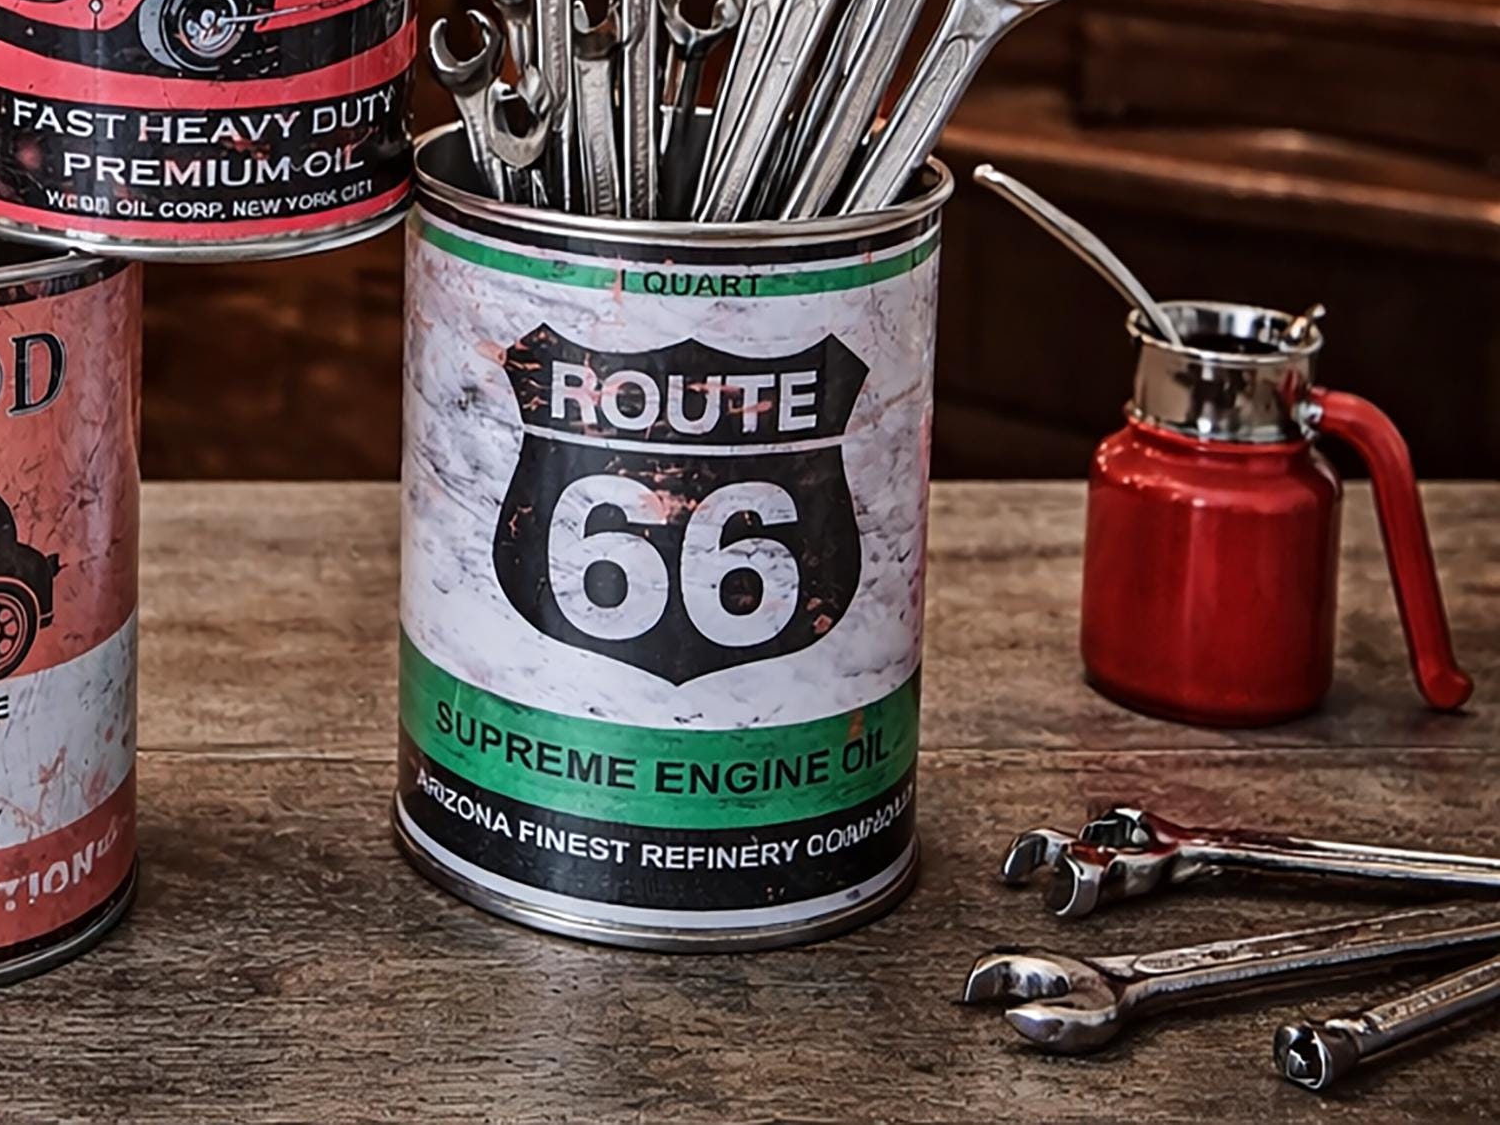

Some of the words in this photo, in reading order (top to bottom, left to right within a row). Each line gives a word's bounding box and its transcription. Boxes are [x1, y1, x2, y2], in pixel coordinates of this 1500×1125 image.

[12, 97, 125, 141] FAST
[137, 111, 301, 145] HEAVY
[312, 85, 395, 135] DUTY
[63, 152, 291, 187] PREMIUM
[304, 144, 364, 178] OIL
[116, 200, 153, 217] OIL
[158, 201, 227, 219] CORP.
[232, 197, 282, 217] NEW
[643, 271, 762, 297] QUART
[550, 360, 817, 435] ROUTE
[548, 474, 799, 648] 66
[435, 699, 638, 790] SUPREME
[654, 748, 831, 795] ENGINE
[840, 729, 892, 773] OIL
[518, 819, 631, 865] FINEST
[640, 837, 799, 870] REFINERY
